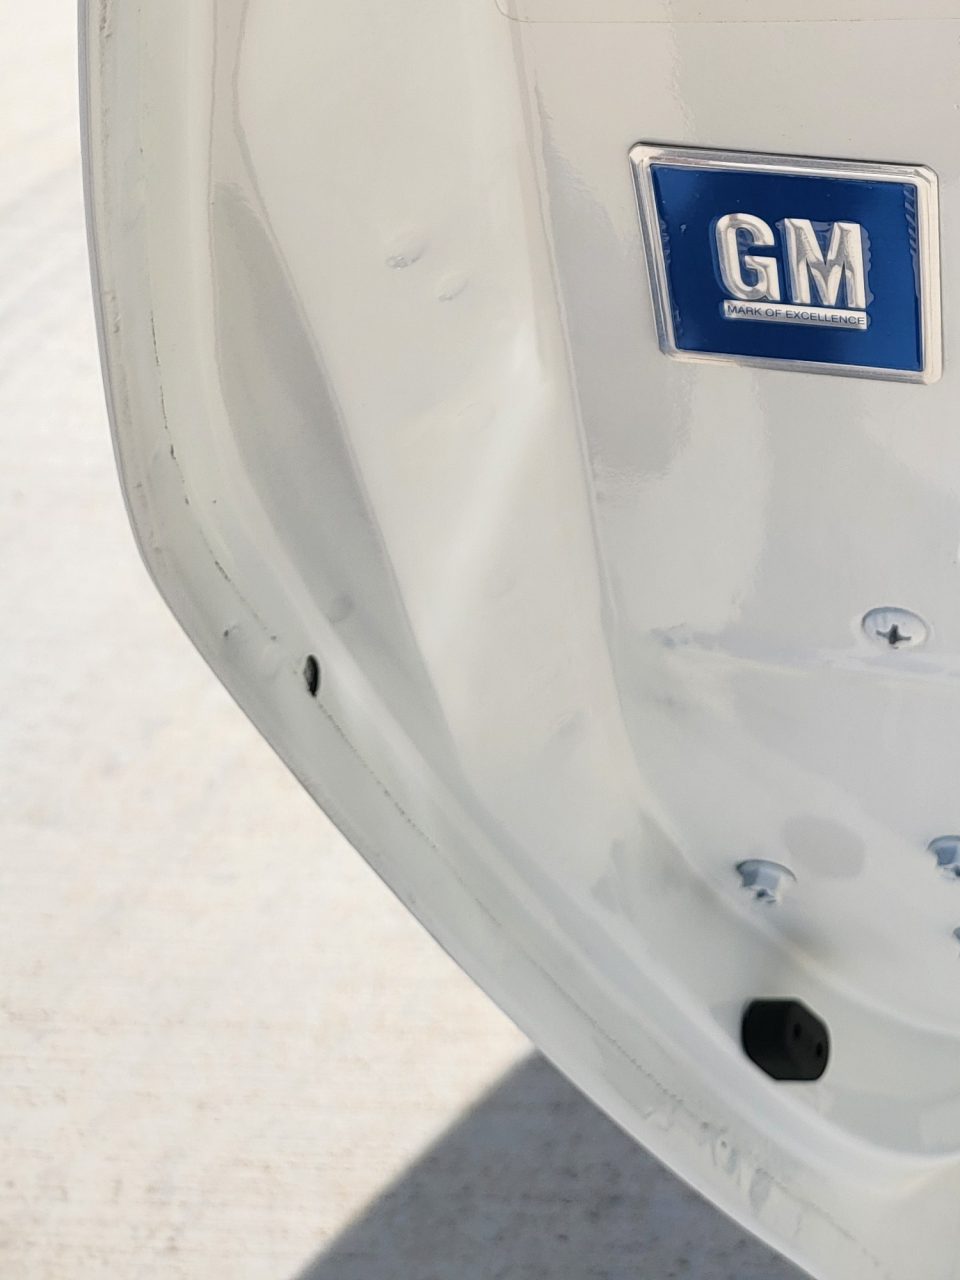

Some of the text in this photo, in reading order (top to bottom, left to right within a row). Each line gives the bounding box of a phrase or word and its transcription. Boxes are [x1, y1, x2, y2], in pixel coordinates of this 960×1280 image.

[715, 212, 867, 309] GM
[727, 303, 866, 326] MARK OF EXCELLENCE
